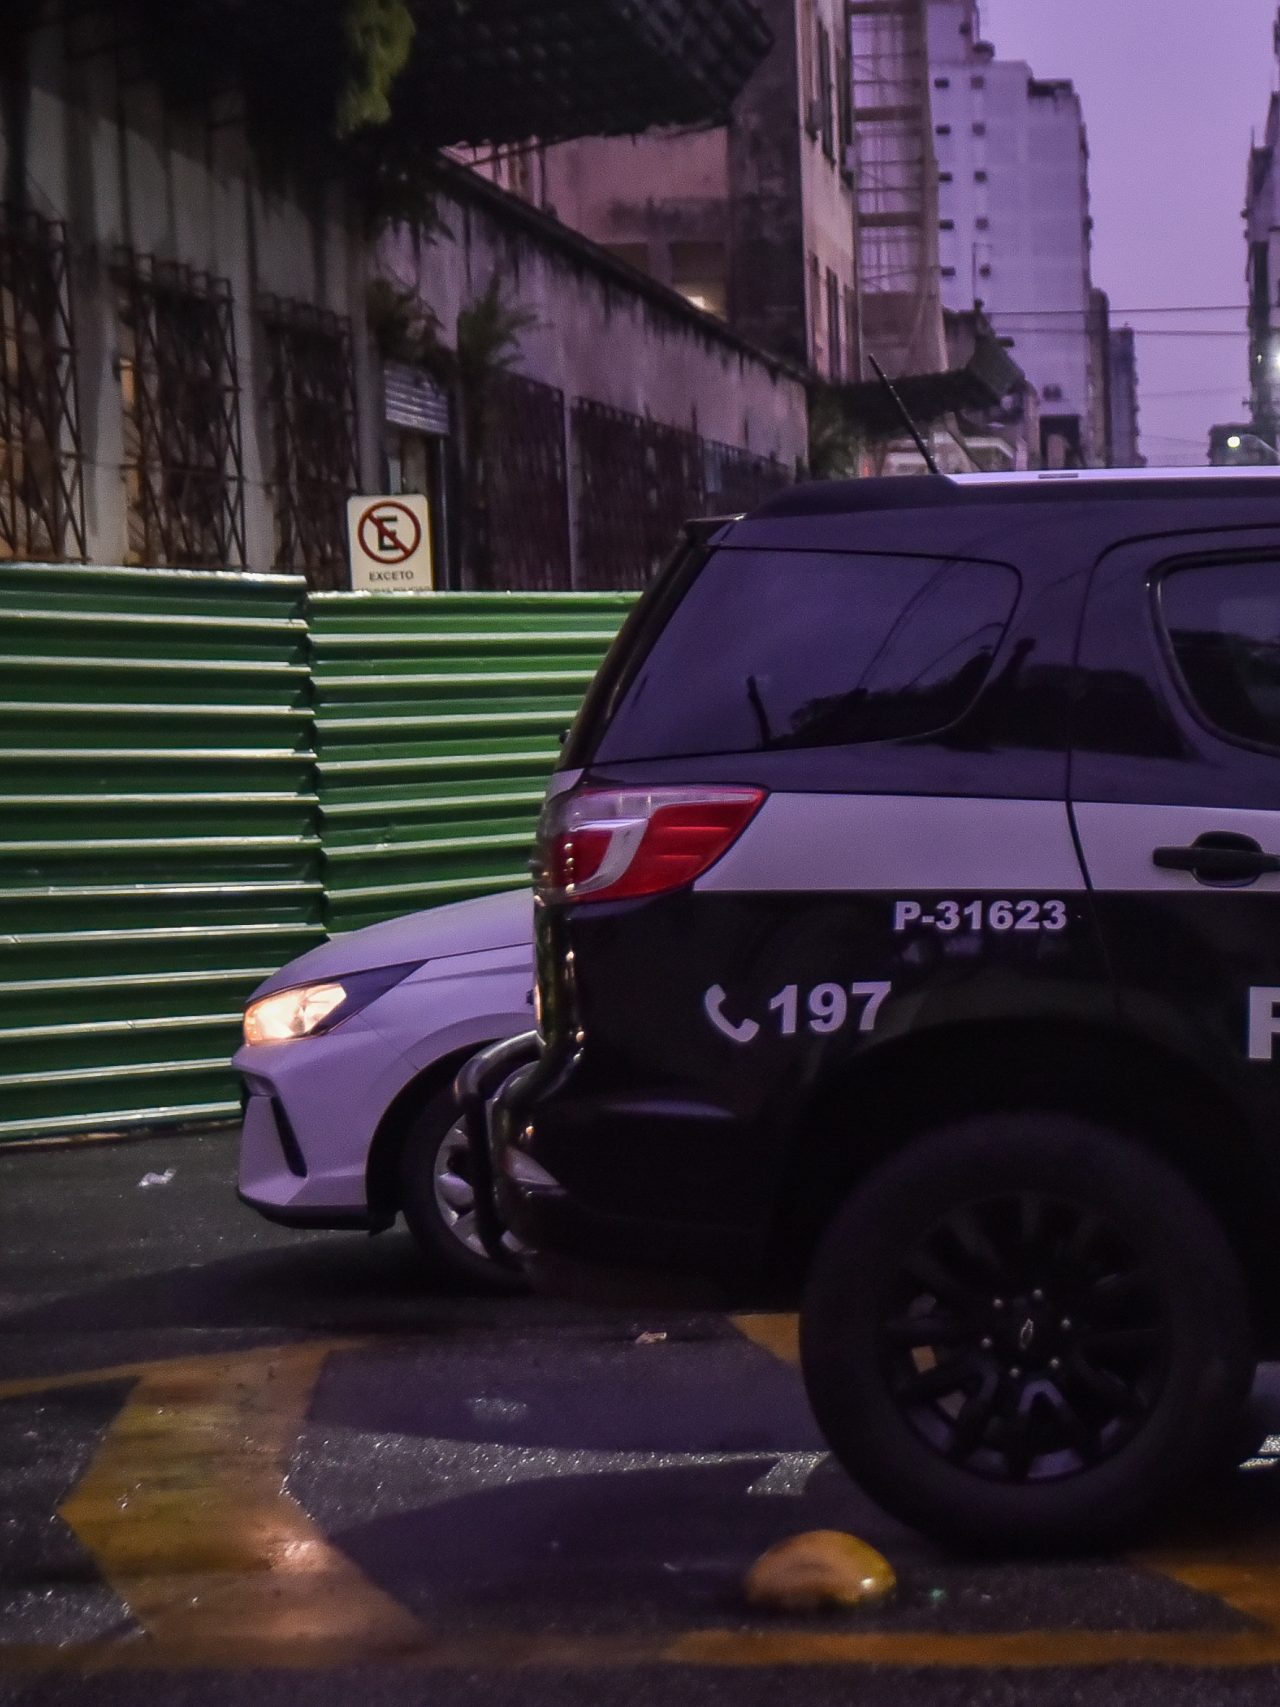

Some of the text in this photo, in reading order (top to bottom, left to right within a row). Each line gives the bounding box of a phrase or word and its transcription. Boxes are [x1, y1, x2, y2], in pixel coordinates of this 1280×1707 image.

[368, 570, 414, 581] EXCETO
[893, 900, 1067, 931] P-31623
[768, 981, 892, 1035] 197
